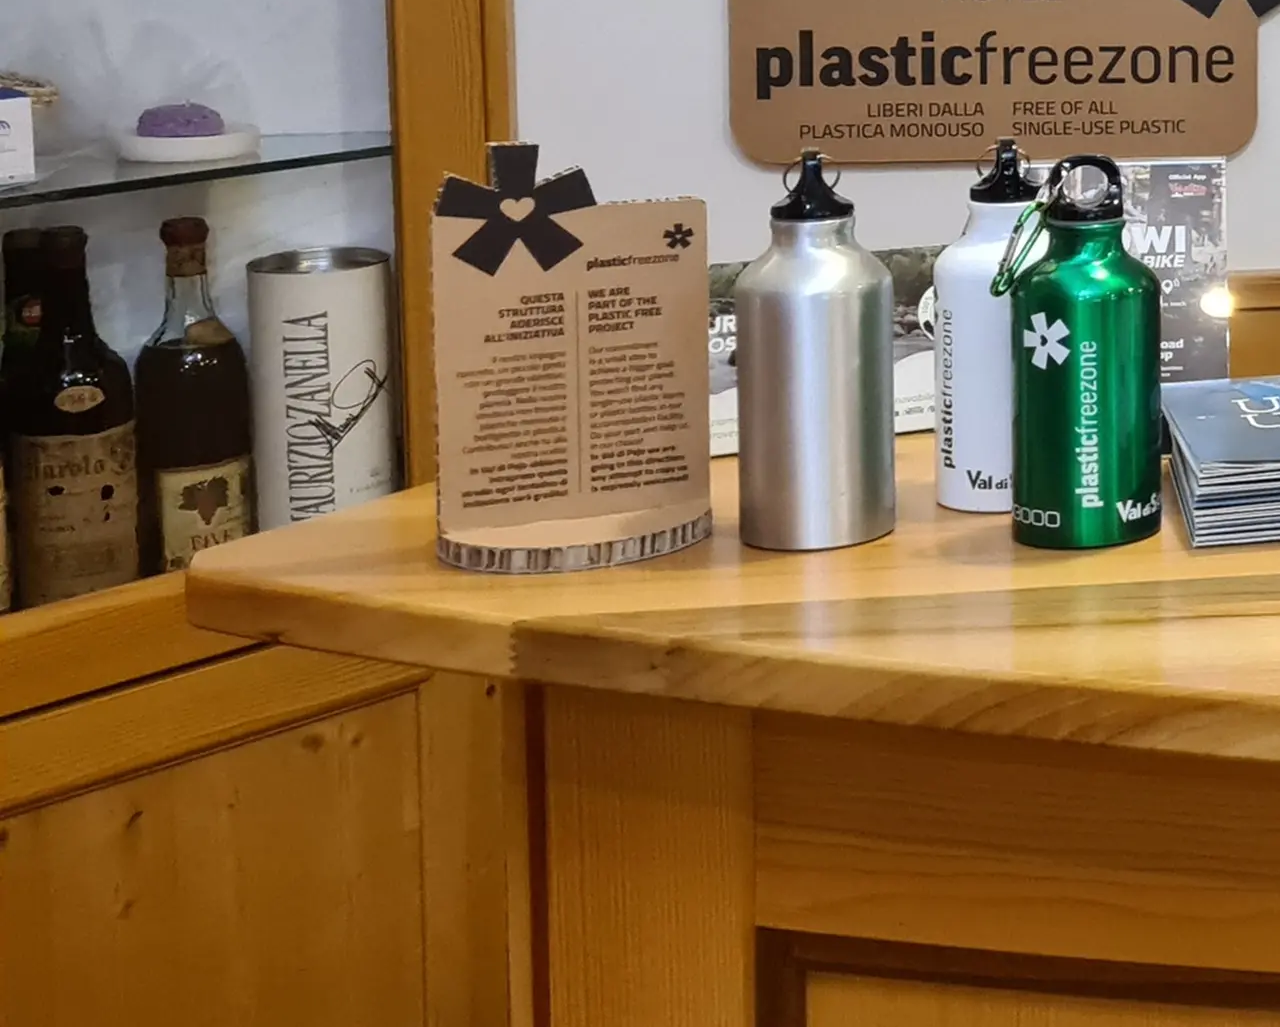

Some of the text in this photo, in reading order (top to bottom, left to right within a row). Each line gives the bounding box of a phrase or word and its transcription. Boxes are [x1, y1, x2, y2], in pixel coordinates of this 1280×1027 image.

[756, 30, 1236, 100] plasticfreezone
[867, 101, 985, 118] LIBERI DALLA
[1012, 100, 1118, 116] FREE OF ALL
[799, 121, 985, 140] PLASTICA MONOUSO
[1012, 118, 1186, 137] SINGLE-USE PLASTIC
[586, 253, 679, 271] plasticfreezone
[1144, 254, 1186, 268] BIKE
[520, 292, 564, 306] QUESTA
[588, 286, 631, 298] WE ARE
[588, 296, 658, 310] PART OF THE
[498, 305, 565, 319] STRUTTURA
[588, 307, 663, 322] PLASTIC FREE
[510, 316, 564, 329] ADERISCE
[588, 321, 635, 334] PROJECT
[1160, 338, 1184, 349] oad
[282, 311, 332, 419] ZANELLA
[941, 310, 956, 469] plasticfreezone
[1075, 341, 1104, 508] plasticfreezone
[966, 470, 1008, 490] Val di
[1116, 499, 1141, 523] Val
